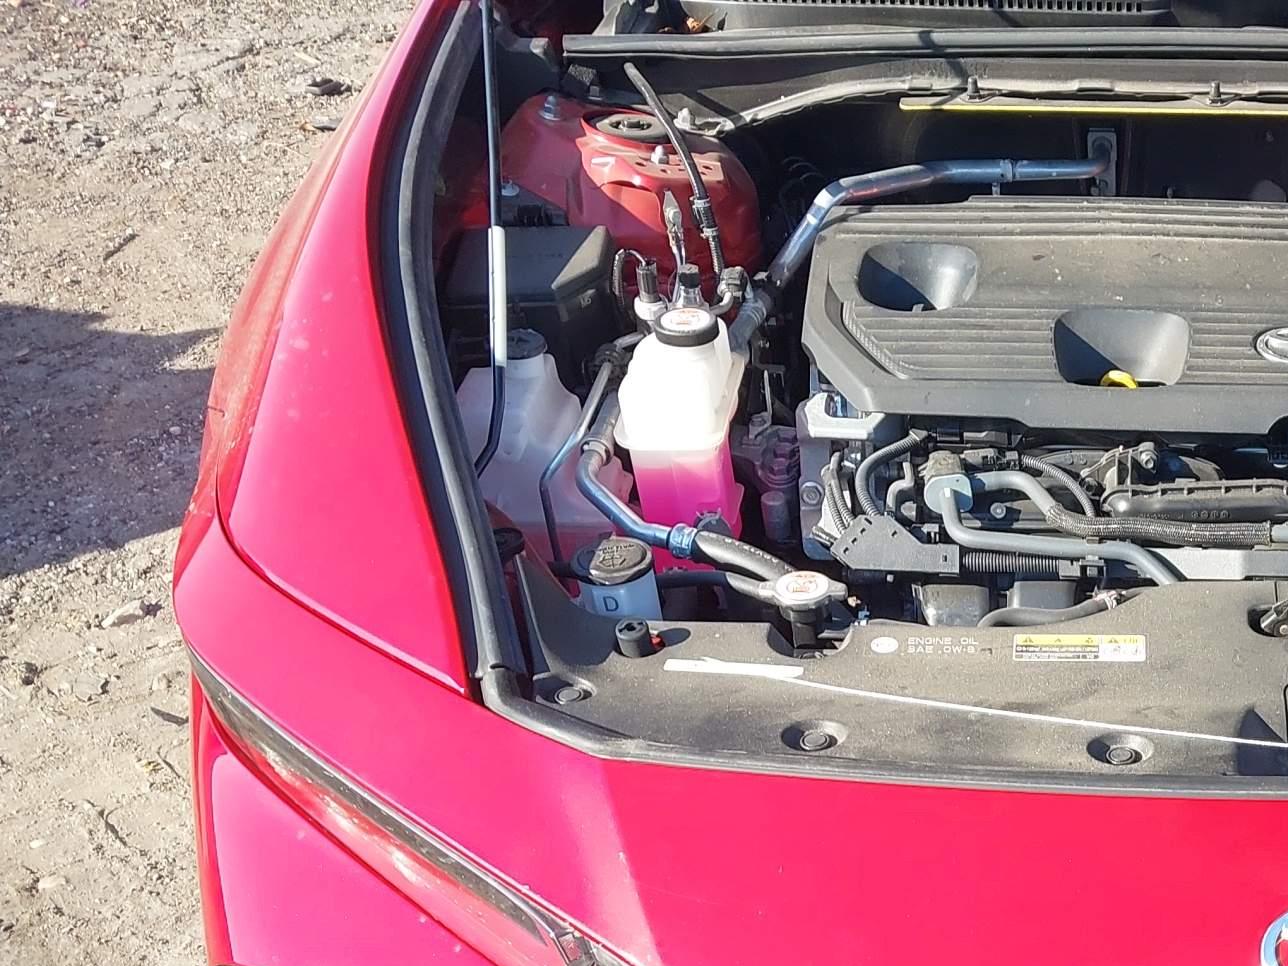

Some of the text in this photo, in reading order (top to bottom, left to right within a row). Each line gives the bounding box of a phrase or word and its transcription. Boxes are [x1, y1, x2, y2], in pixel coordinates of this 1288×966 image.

[604, 596, 619, 613] D
[907, 637, 979, 645] ENGINE OIL
[907, 645, 934, 654] SAE
